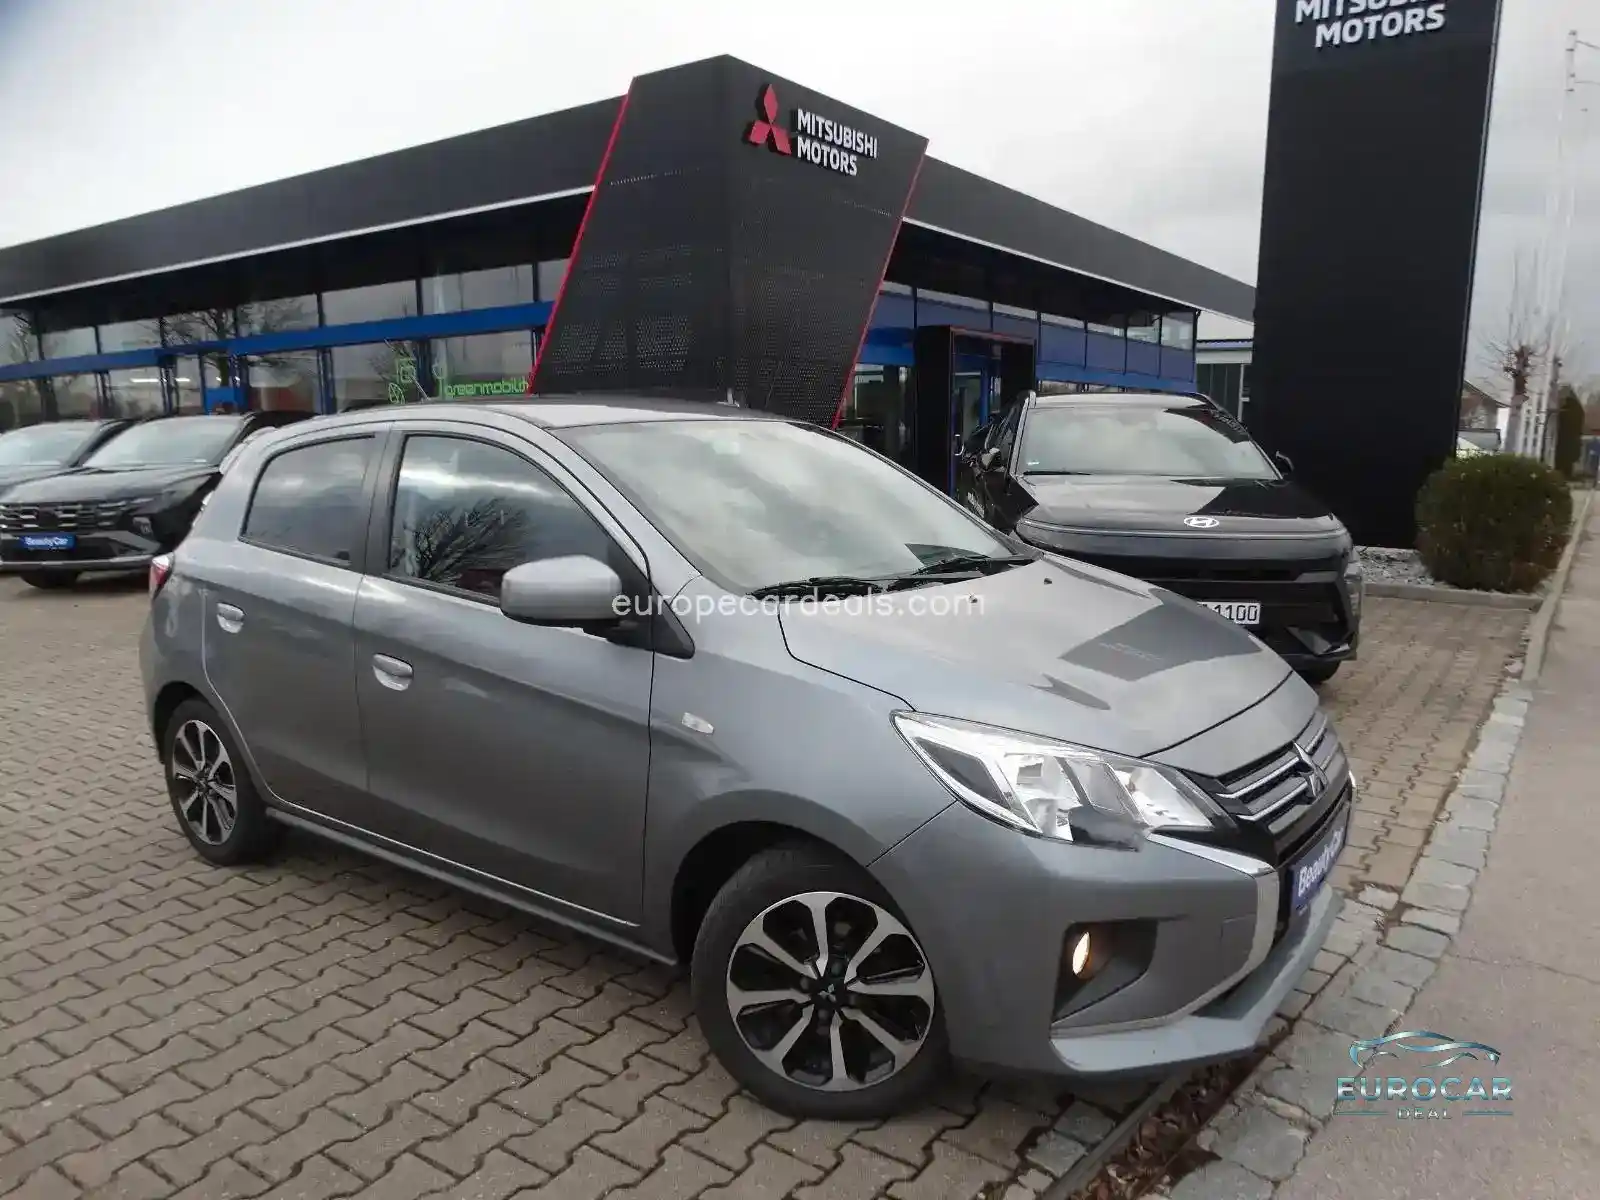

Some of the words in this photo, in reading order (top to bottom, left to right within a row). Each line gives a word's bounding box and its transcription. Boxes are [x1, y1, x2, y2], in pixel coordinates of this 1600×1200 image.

[1315, 4, 1446, 48] MOTORS
[797, 108, 878, 158] MITSUBISHI
[797, 136, 858, 176] MOTORS
